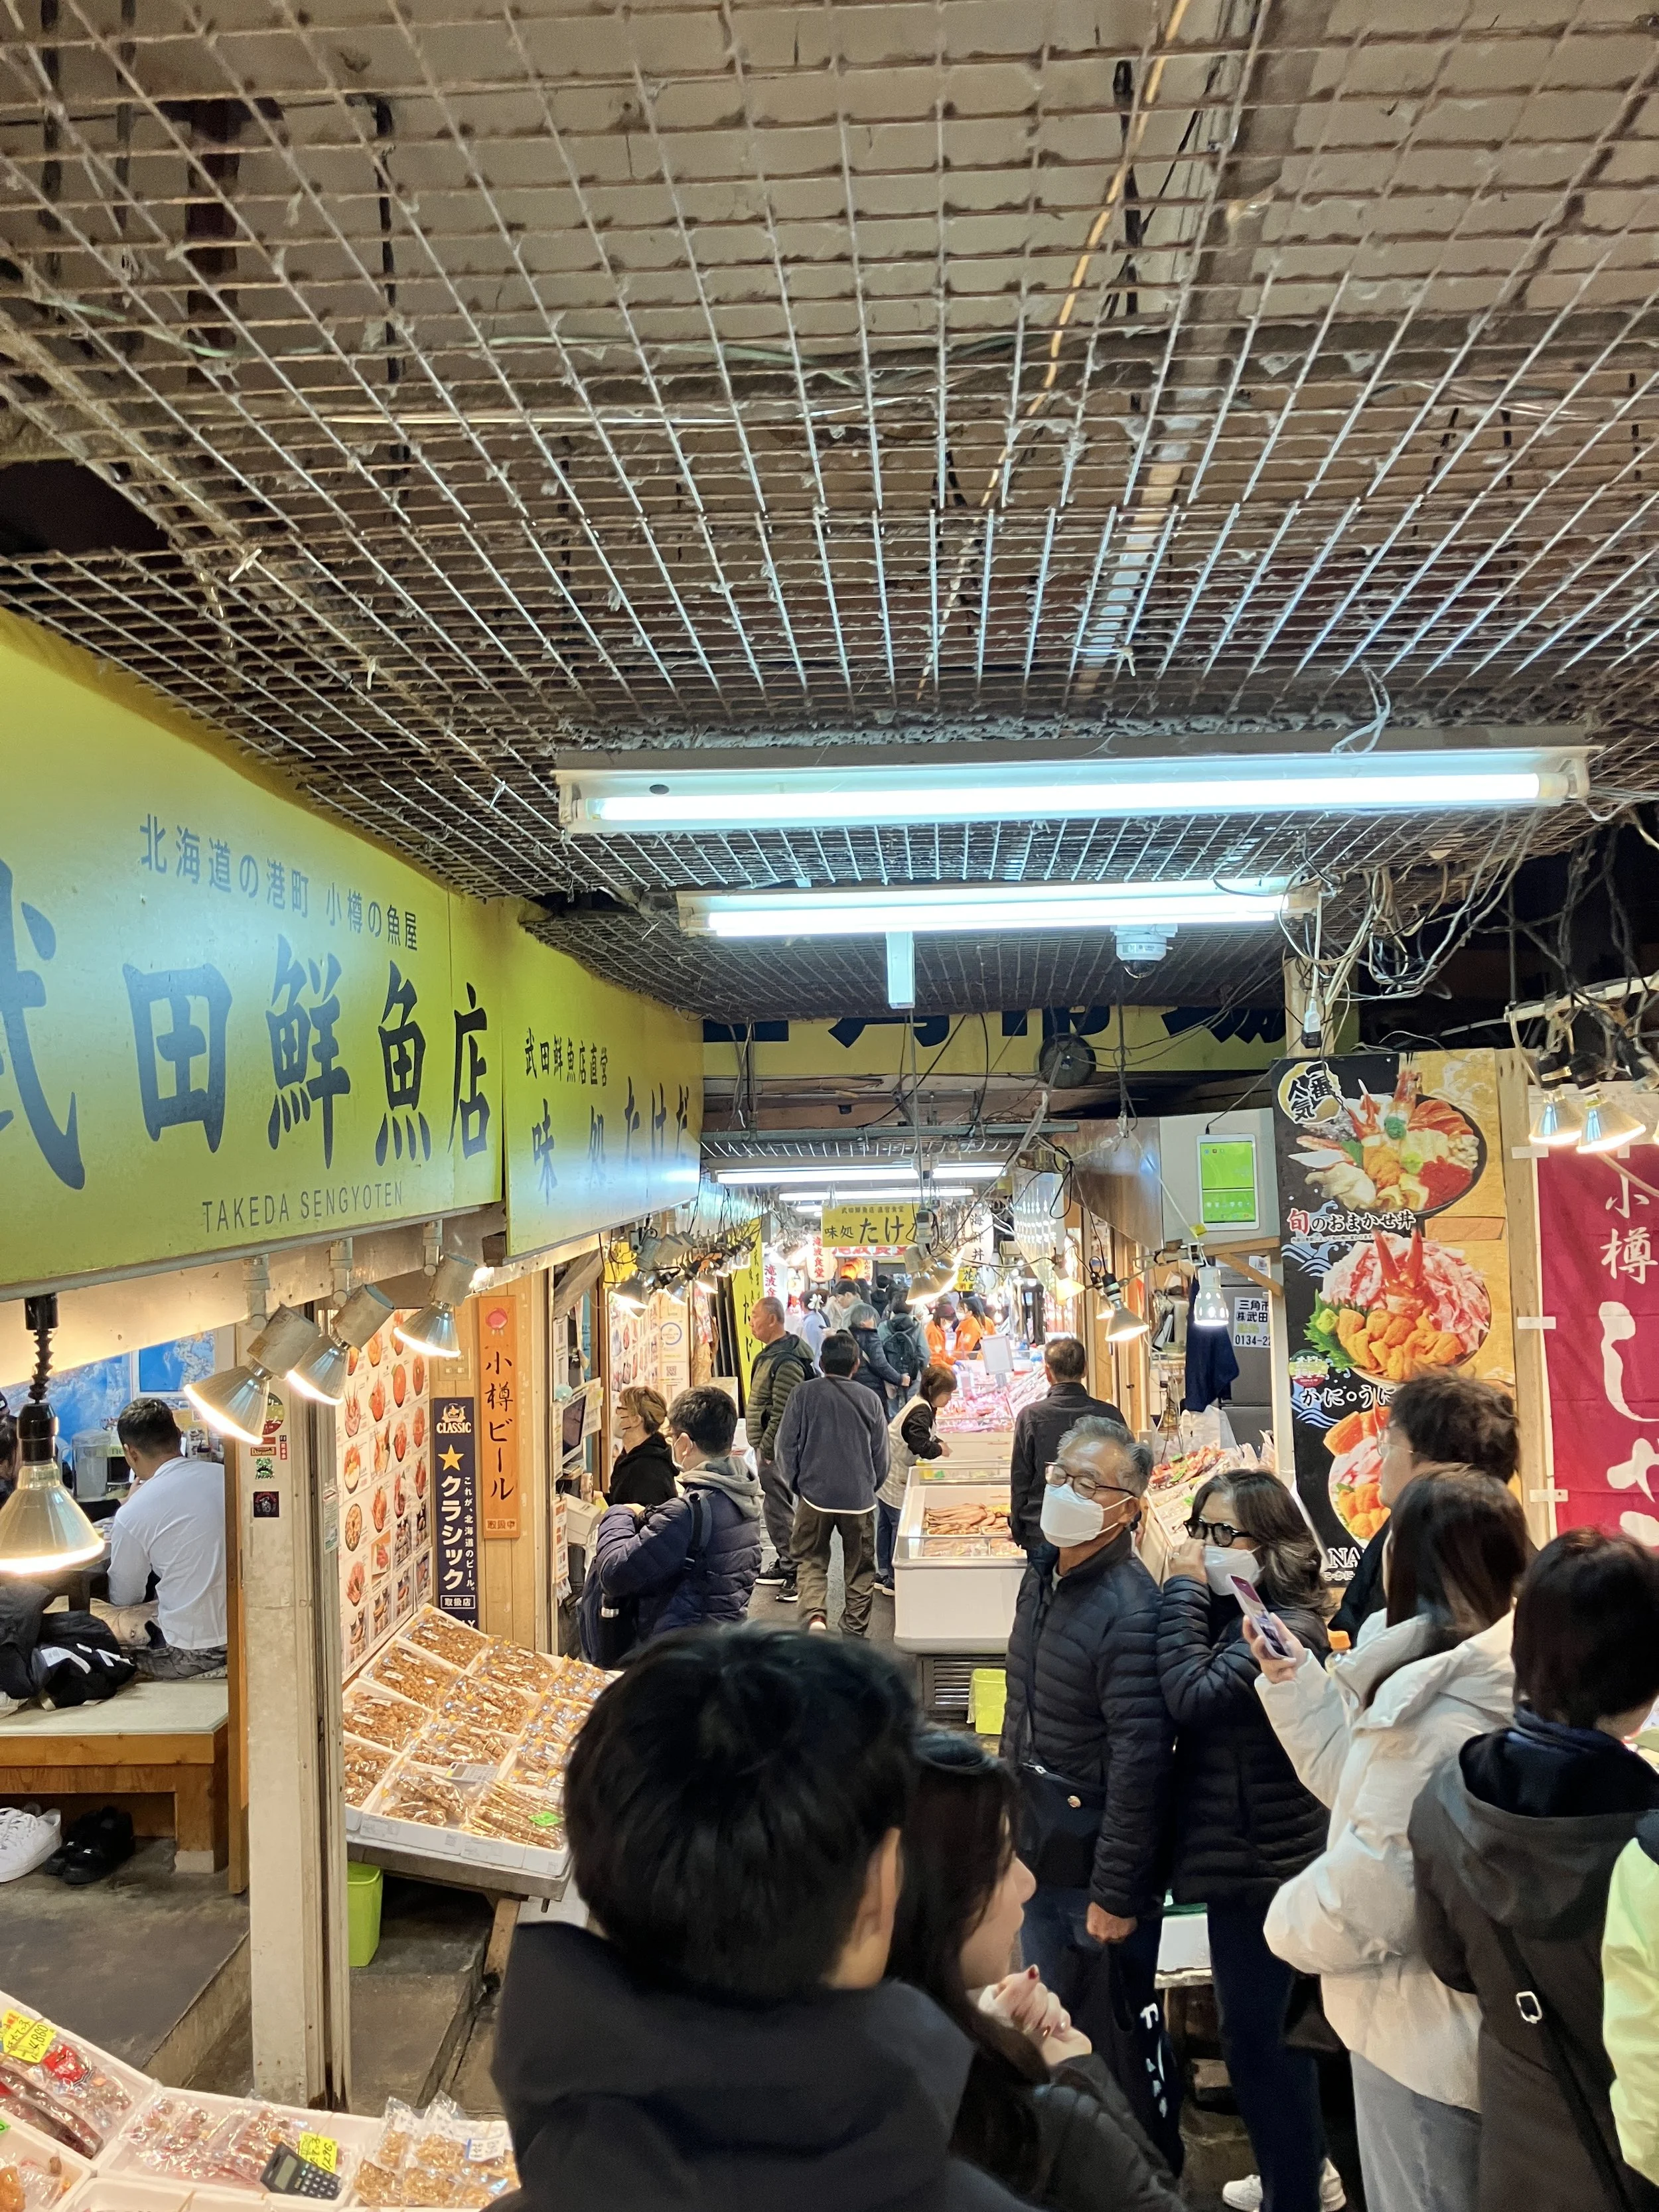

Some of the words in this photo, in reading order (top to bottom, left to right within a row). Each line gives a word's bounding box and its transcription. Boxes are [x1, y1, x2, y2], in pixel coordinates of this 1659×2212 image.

[139, 813, 309, 918] 北海道の港町
[326, 881, 418, 958] 小樽の魚屋
[525, 1027, 608, 1087] 武田鮮魚店直営
[202, 1193, 289, 1232] TAKEDA
[301, 1181, 402, 1220] SENGYOTEN
[825, 1224, 854, 1240] 味処
[1287, 1208, 1417, 1235] 旬のおまかせ丼
[1600, 1173, 1658, 1284] 小樽
[812, 1236, 825, 1278] 滝波食堂
[436, 1422, 471, 1434] CLASSIC
[484, 1351, 514, 1501] 小樽ビール
[441, 1475, 464, 1590] クラシック
[464, 1477, 475, 1591] これが、北海道のビール。
[445, 1597, 471, 1606] 取扱店
